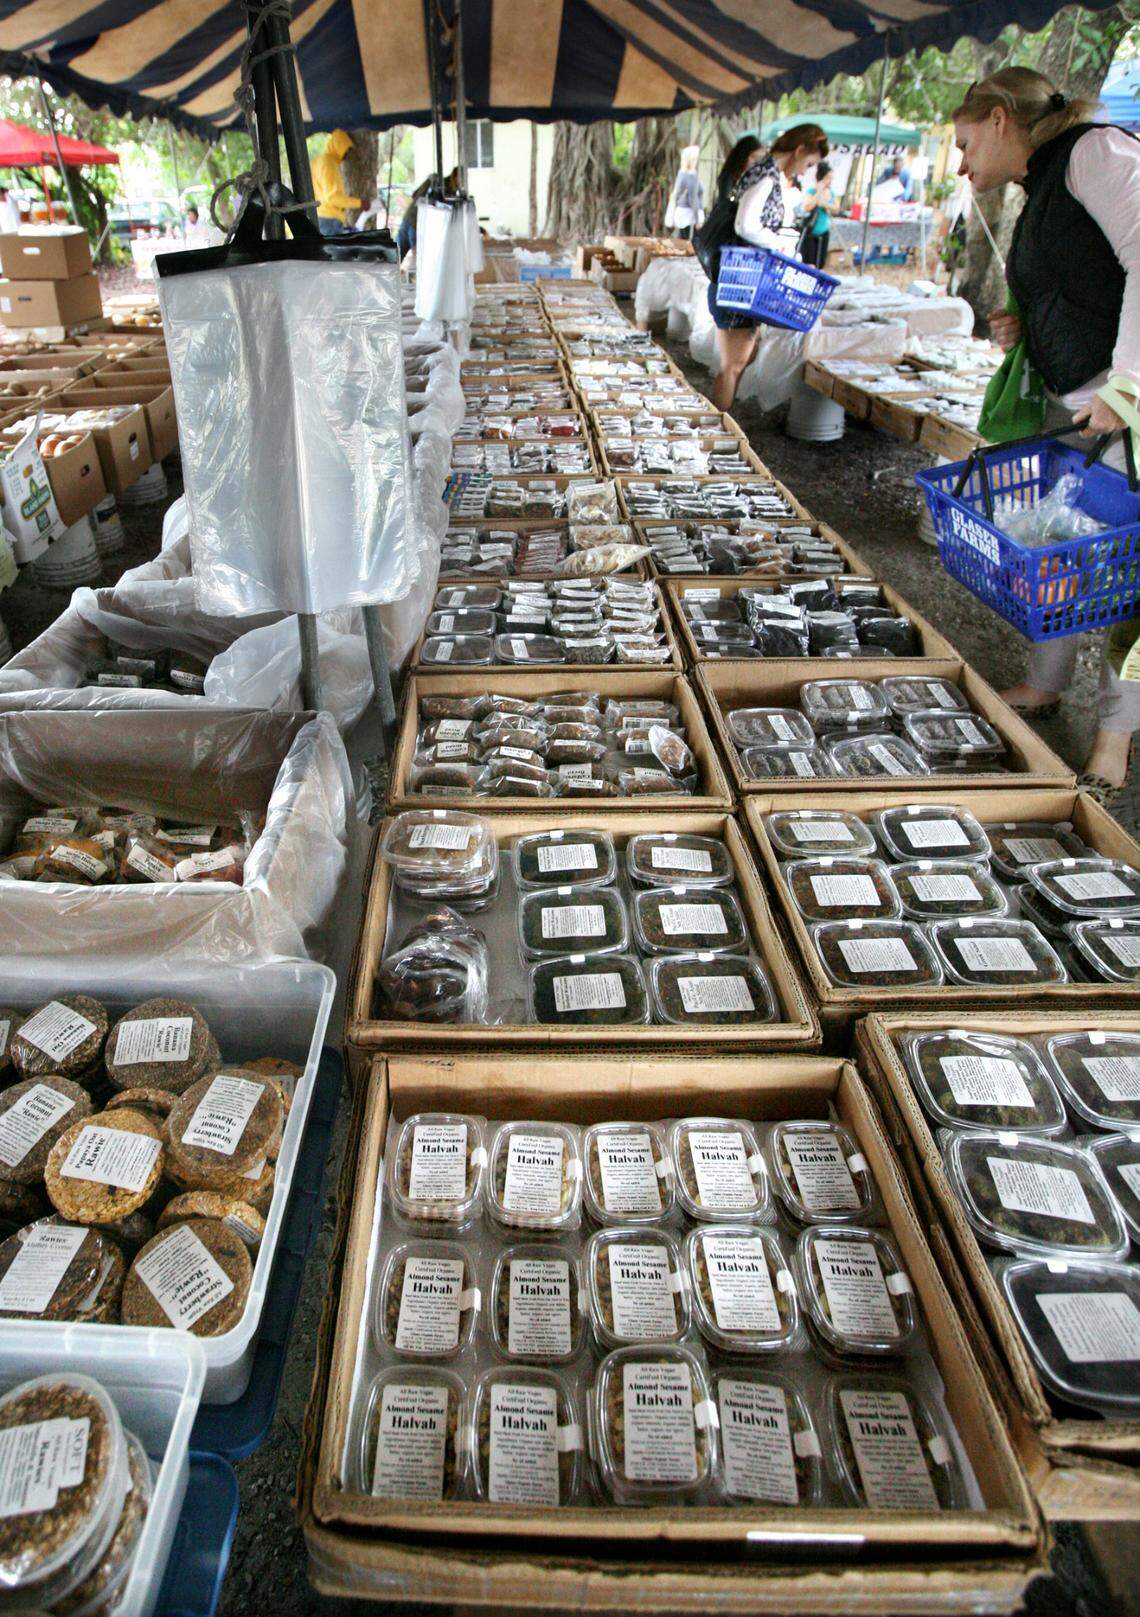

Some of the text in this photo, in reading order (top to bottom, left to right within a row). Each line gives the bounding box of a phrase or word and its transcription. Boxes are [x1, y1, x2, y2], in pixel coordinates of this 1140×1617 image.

[951, 507, 999, 552] GLASER
[953, 520, 1000, 566] FARMS
[26, 1100, 52, 1117] Coconut
[33, 1095, 56, 1110] Banana
[201, 1121, 231, 1134] Coconut
[193, 1129, 232, 1144] Strawberry
[422, 1145, 459, 1153] Halvah
[517, 1155, 554, 1166] Halvah
[608, 1155, 646, 1163] Halvah
[701, 1152, 739, 1160] Halvah
[798, 1153, 837, 1162] Halvah
[641, 1261, 667, 1269] Sesame
[717, 1261, 759, 1272] Halvah
[830, 1264, 874, 1277] Halvah
[620, 1268, 662, 1280] Halvah
[179, 1277, 211, 1304] Coconut
[413, 1282, 453, 1294] Halvah
[520, 1284, 560, 1295] Halvah
[179, 1280, 223, 1316] Strawberry
[628, 1382, 689, 1391] Almond Sesame
[636, 1393, 682, 1405] Halvah
[386, 1405, 415, 1413] Almond
[495, 1405, 553, 1415] Almond Sesame
[392, 1415, 436, 1430] Halvah
[502, 1415, 547, 1431] Halvah
[732, 1410, 779, 1428] Halvah
[859, 1421, 907, 1436] Halvah
